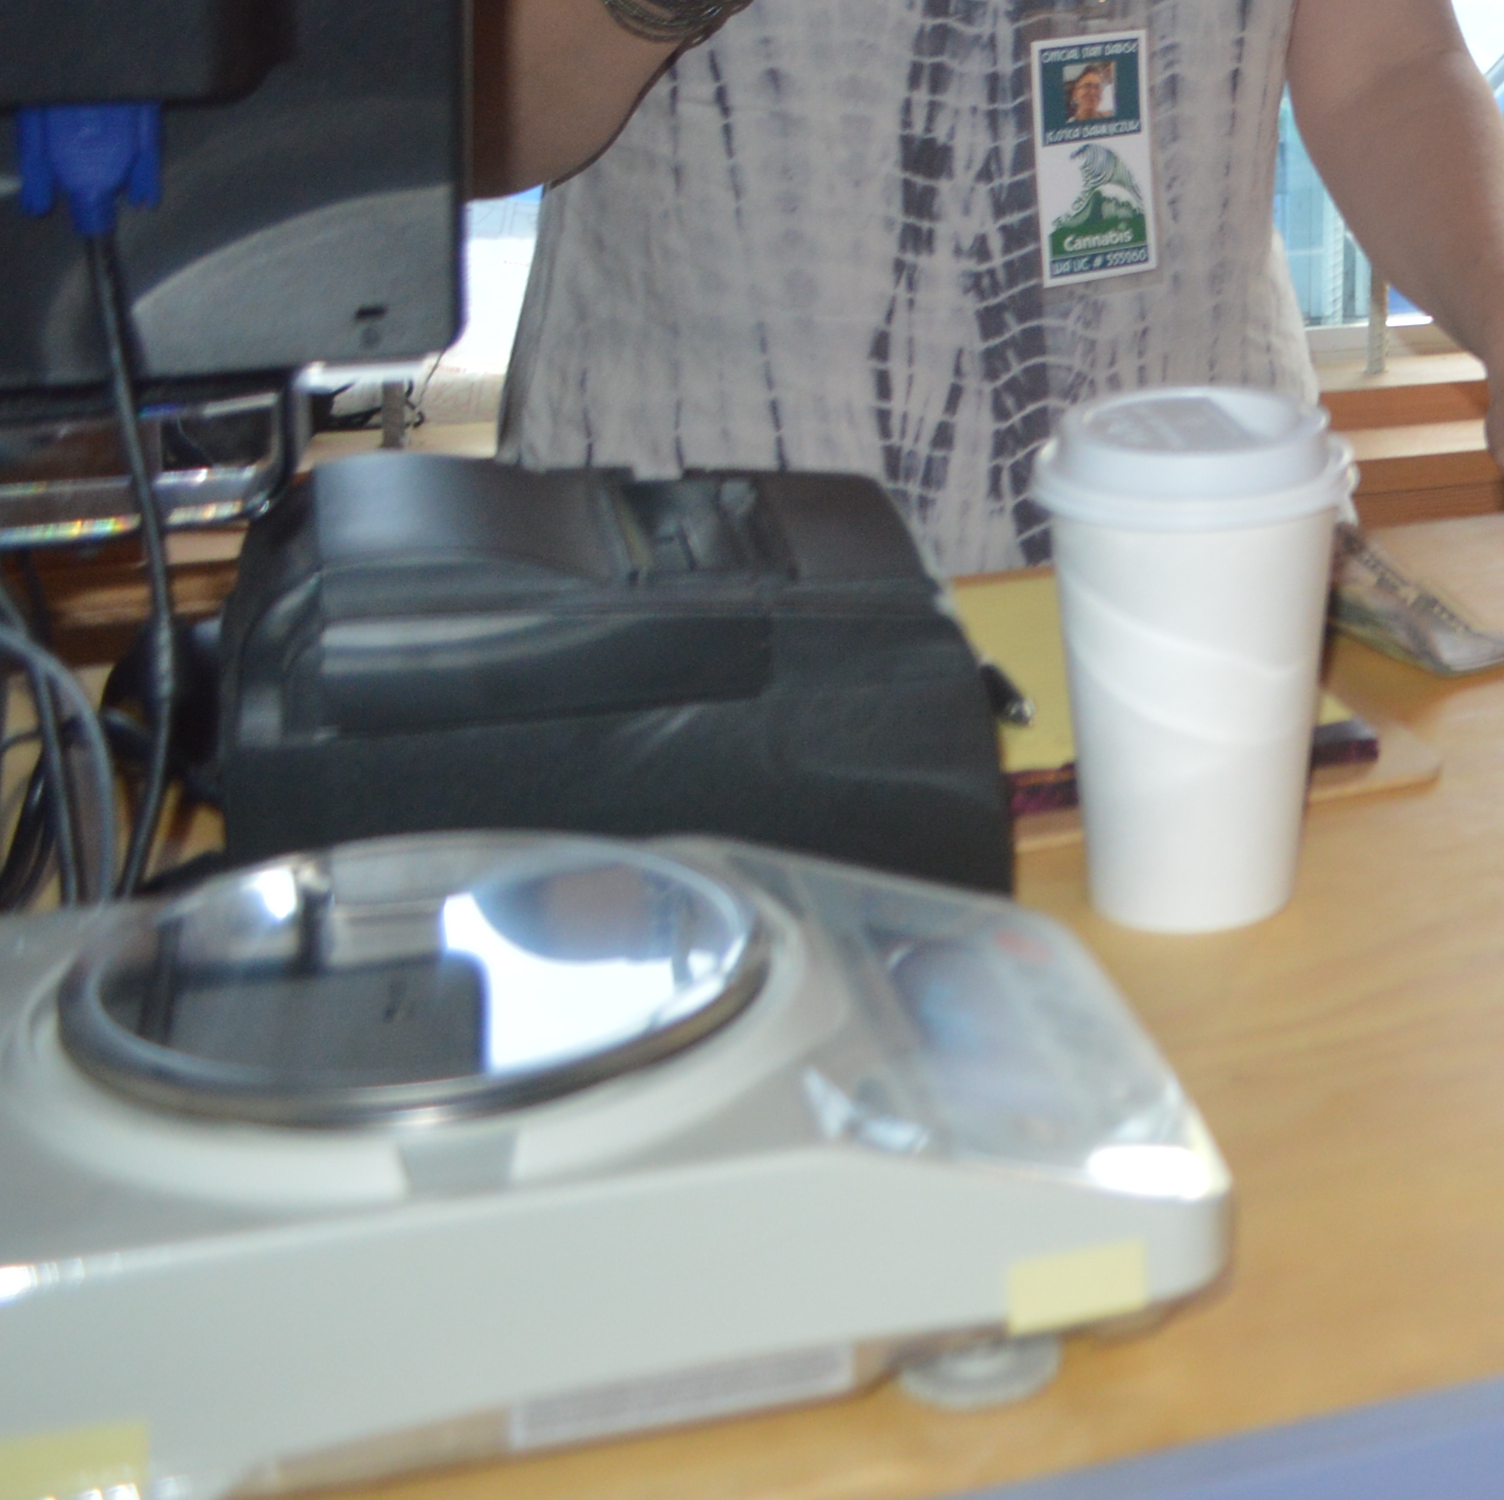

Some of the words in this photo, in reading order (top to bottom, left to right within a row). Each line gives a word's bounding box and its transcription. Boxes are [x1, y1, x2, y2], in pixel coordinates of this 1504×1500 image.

[1042, 48, 1079, 63] OFFICIAL
[1104, 41, 1137, 56] BADGE
[1063, 229, 1133, 252] Cannabis
